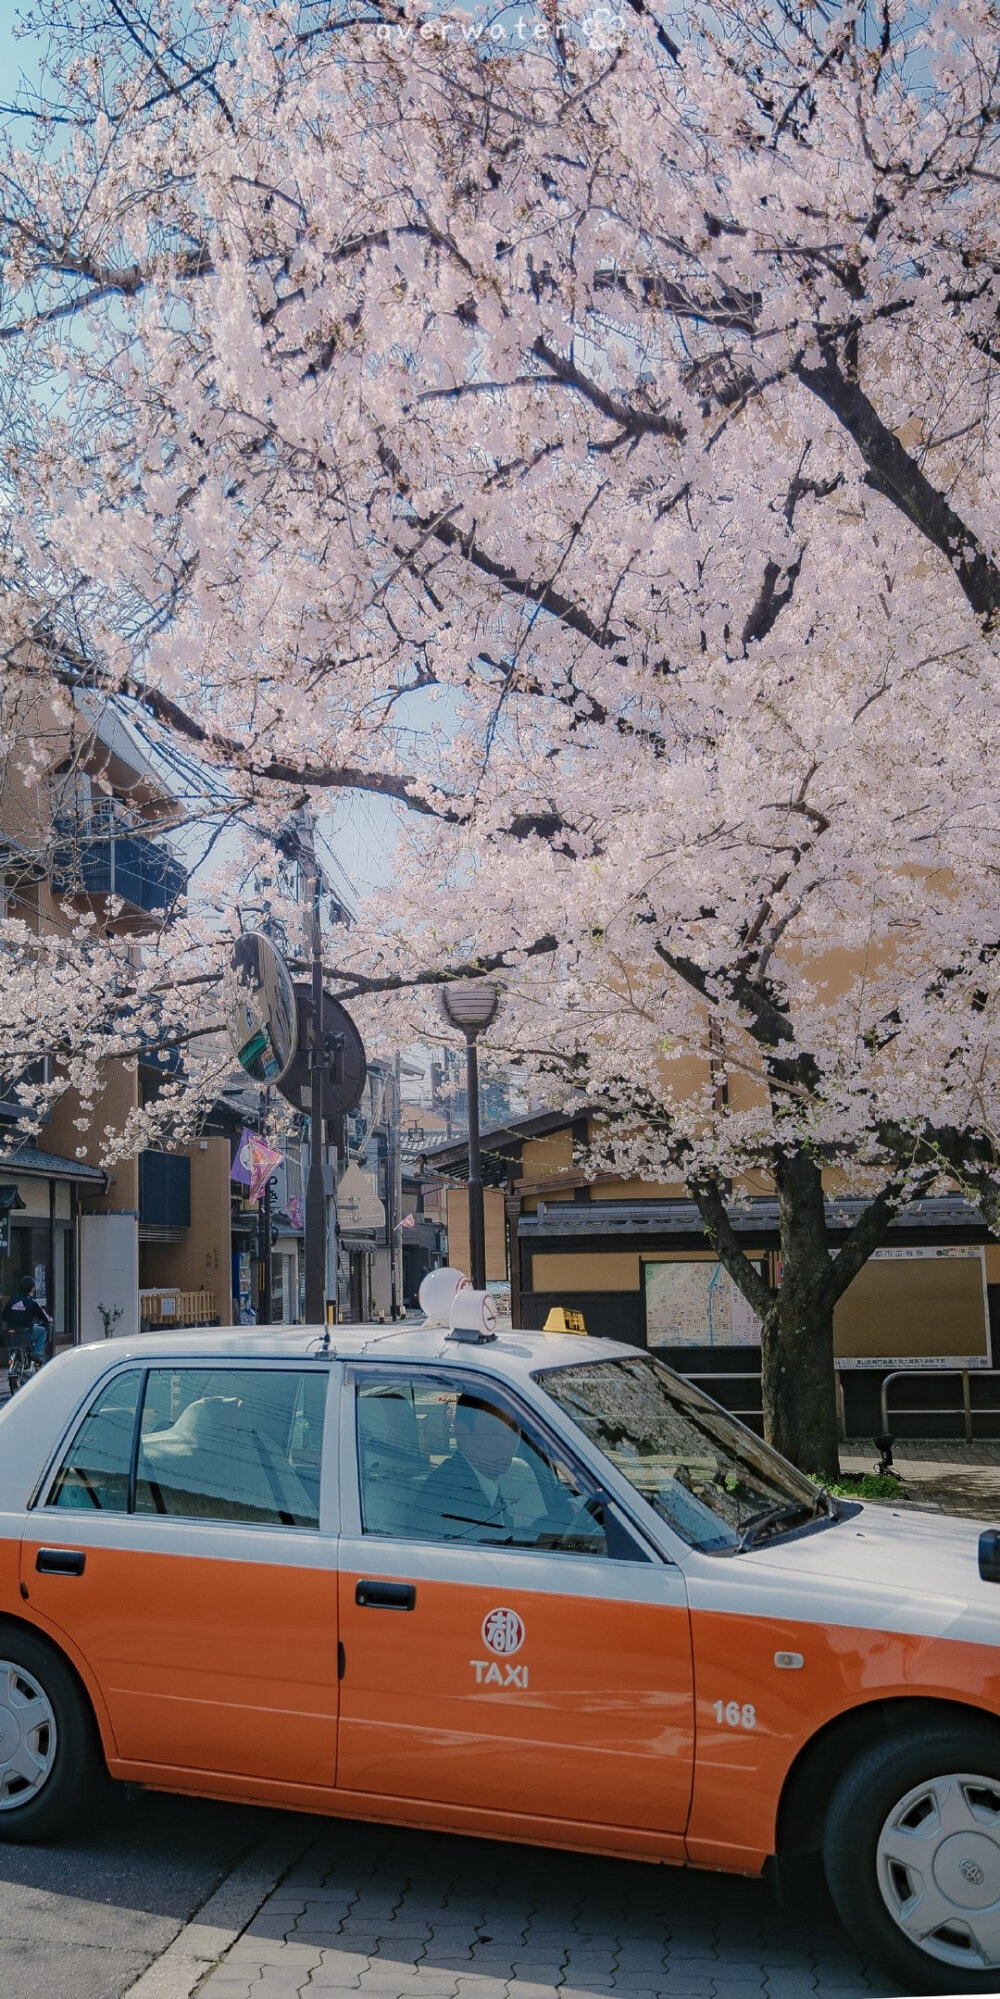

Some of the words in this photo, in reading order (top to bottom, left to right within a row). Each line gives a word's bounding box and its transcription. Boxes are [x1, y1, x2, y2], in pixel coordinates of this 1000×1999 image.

[485, 1611, 519, 1652] 都
[469, 1660, 529, 1689] TAXI
[714, 1699, 756, 1730] 168
